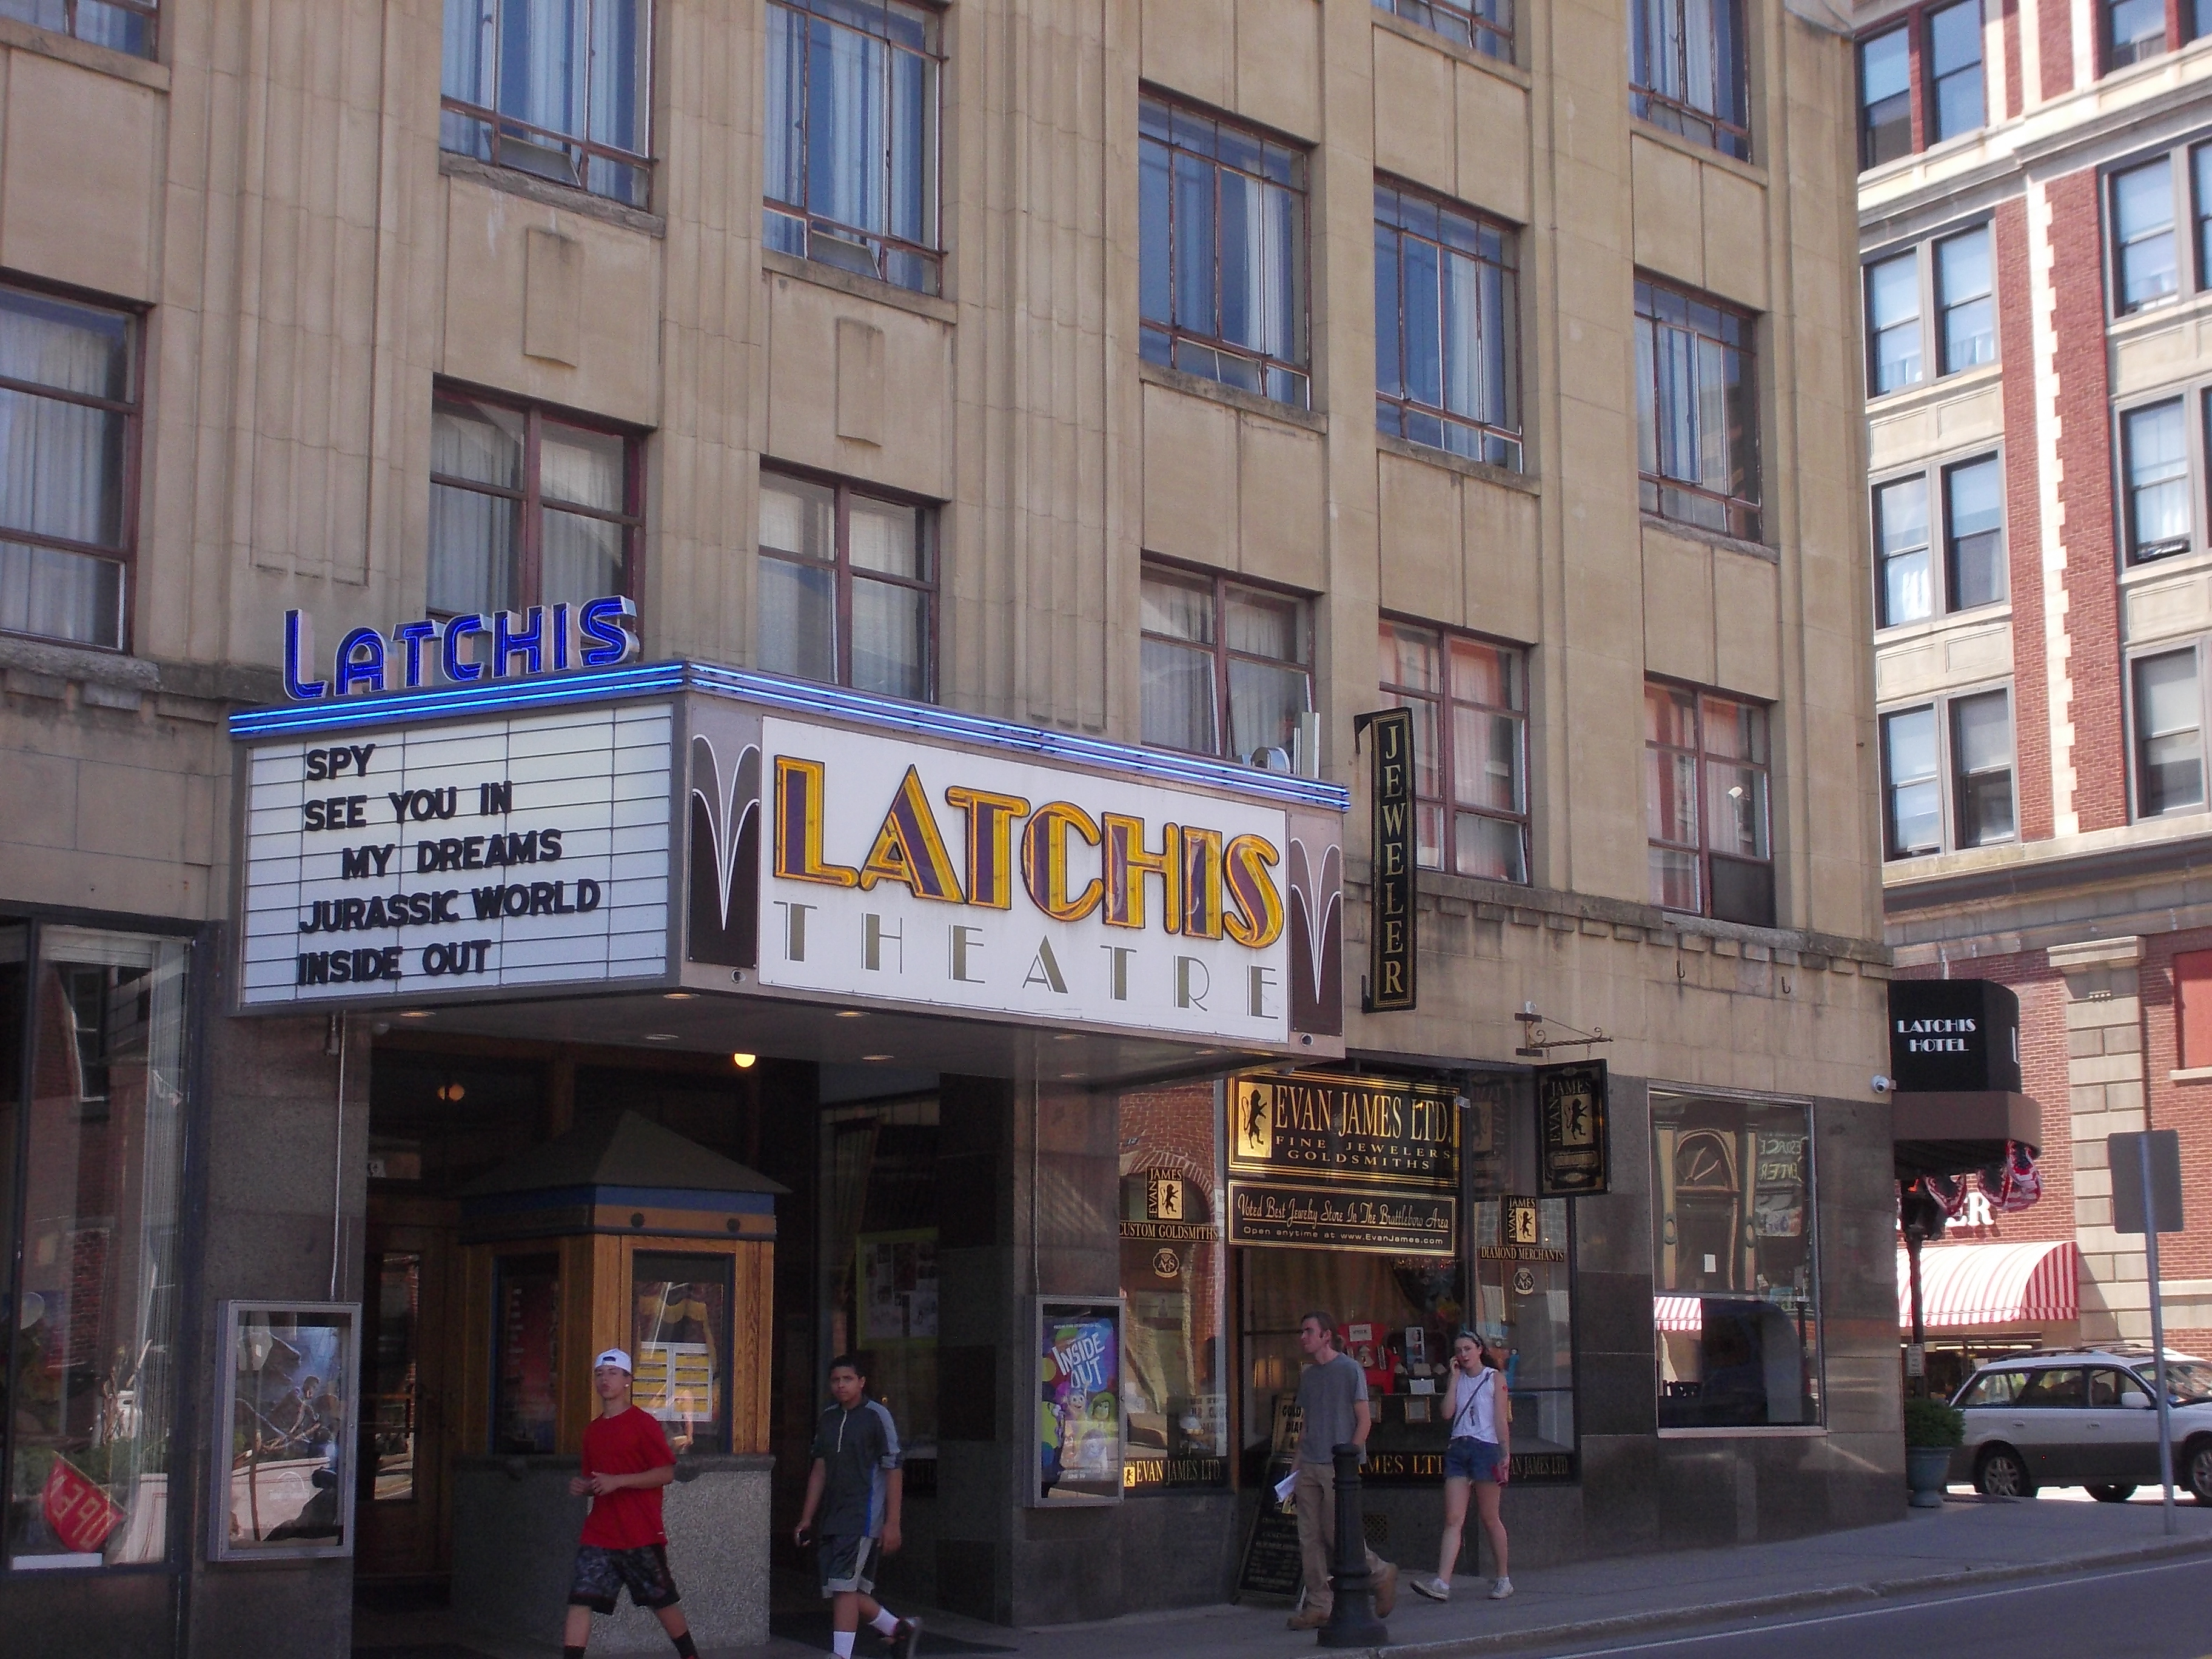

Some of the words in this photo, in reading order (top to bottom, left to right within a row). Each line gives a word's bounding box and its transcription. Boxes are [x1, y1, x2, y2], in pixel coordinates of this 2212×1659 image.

[284, 595, 640, 701] LATCHIS
[306, 743, 376, 781] SPY
[304, 795, 367, 831] SEE
[388, 786, 457, 824] YOU
[480, 780, 512, 816] IN
[341, 843, 395, 879] MY
[417, 828, 563, 873] DREAMS
[773, 754, 1284, 949] LATCHIS
[1382, 725, 1406, 994] JEWELER
[299, 890, 460, 933] JURASSIC
[471, 879, 601, 920] WORLD
[298, 946, 403, 986] INSIDE
[422, 939, 492, 976] OUT
[773, 901, 1279, 1020] THEATRE
[1897, 1019, 1976, 1033] LATCHIS
[1909, 1038, 1970, 1052] HOTEL
[1551, 1081, 1592, 1096] JAMES
[1275, 1085, 1333, 1132] EVAN
[1338, 1091, 1402, 1139] JAMES
[1410, 1098, 1452, 1144] LTD.
[1275, 1136, 1327, 1149] FINE
[1346, 1141, 1450, 1160] JEWELERS
[1287, 1150, 1430, 1170] GOLDSMITHS
[1150, 1168, 1182, 1181] JAMES
[1148, 1181, 1158, 1214] EVAN
[1238, 1193, 1263, 1218] Voted
[1266, 1196, 1286, 1219] Best
[1286, 1198, 1318, 1230] Jewelry
[1320, 1199, 1344, 1222] Store
[1347, 1202, 1358, 1224] In
[1360, 1202, 1376, 1225] The
[1378, 1203, 1424, 1228] Brattleboro
[1425, 1207, 1449, 1229] Area
[1509, 1198, 1536, 1208] JAMES
[1159, 1224, 1218, 1241] GOLDSMITHS
[1243, 1225, 1271, 1236] Open
[1276, 1228, 1318, 1238] anytime
[1324, 1230, 1335, 1239] at
[1340, 1233, 1444, 1245] www.EvanJames.com
[1508, 1208, 1517, 1239] EVAN
[1481, 1245, 1517, 1259] DIAMOND
[1518, 1248, 1564, 1262] MERCHANTS
[1052, 1332, 1106, 1376] INSIDE
[1070, 1356, 1102, 1389] OUT
[1136, 1460, 1164, 1482] EVAN
[1166, 1460, 1198, 1486] JAMES
